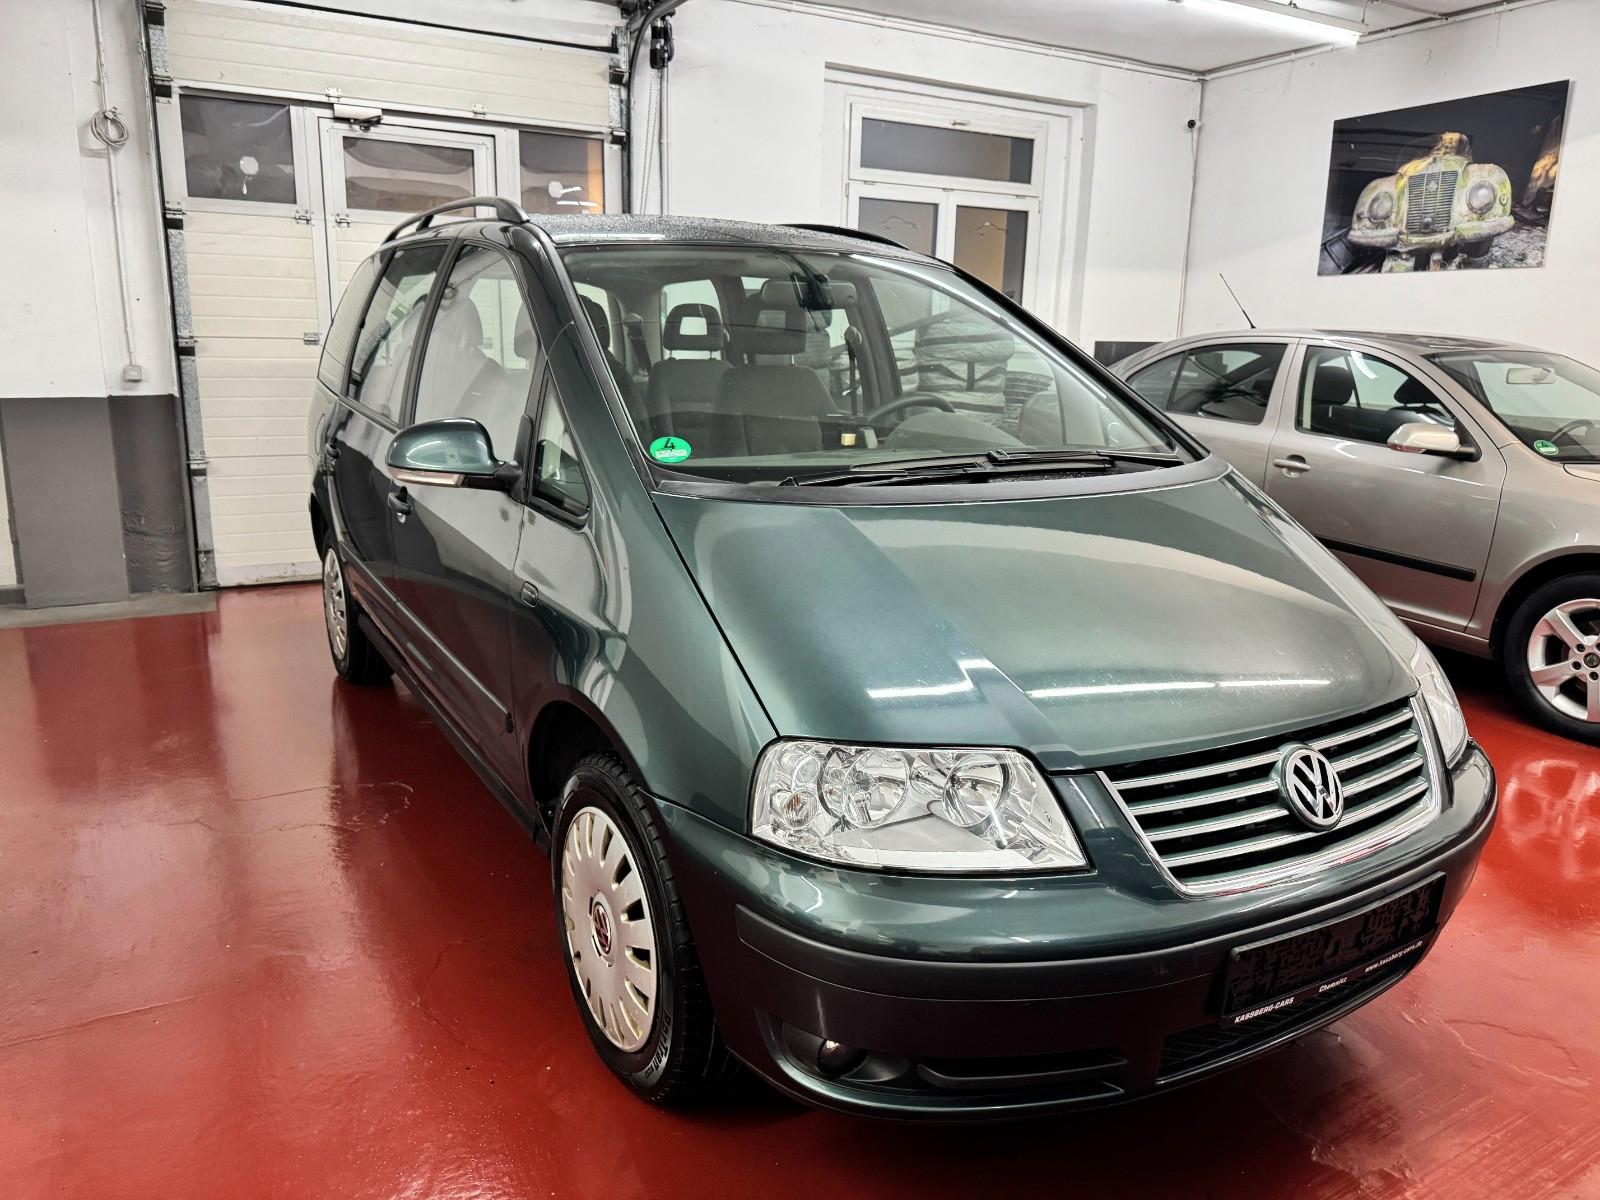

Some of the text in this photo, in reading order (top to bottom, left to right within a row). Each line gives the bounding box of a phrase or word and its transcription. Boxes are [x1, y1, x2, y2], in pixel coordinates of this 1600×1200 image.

[664, 438, 676, 450] 4
[1285, 748, 1344, 826] VW
[1234, 996, 1295, 1024] KASSBERG-CARS
[1318, 977, 1348, 993] Chemnitz
